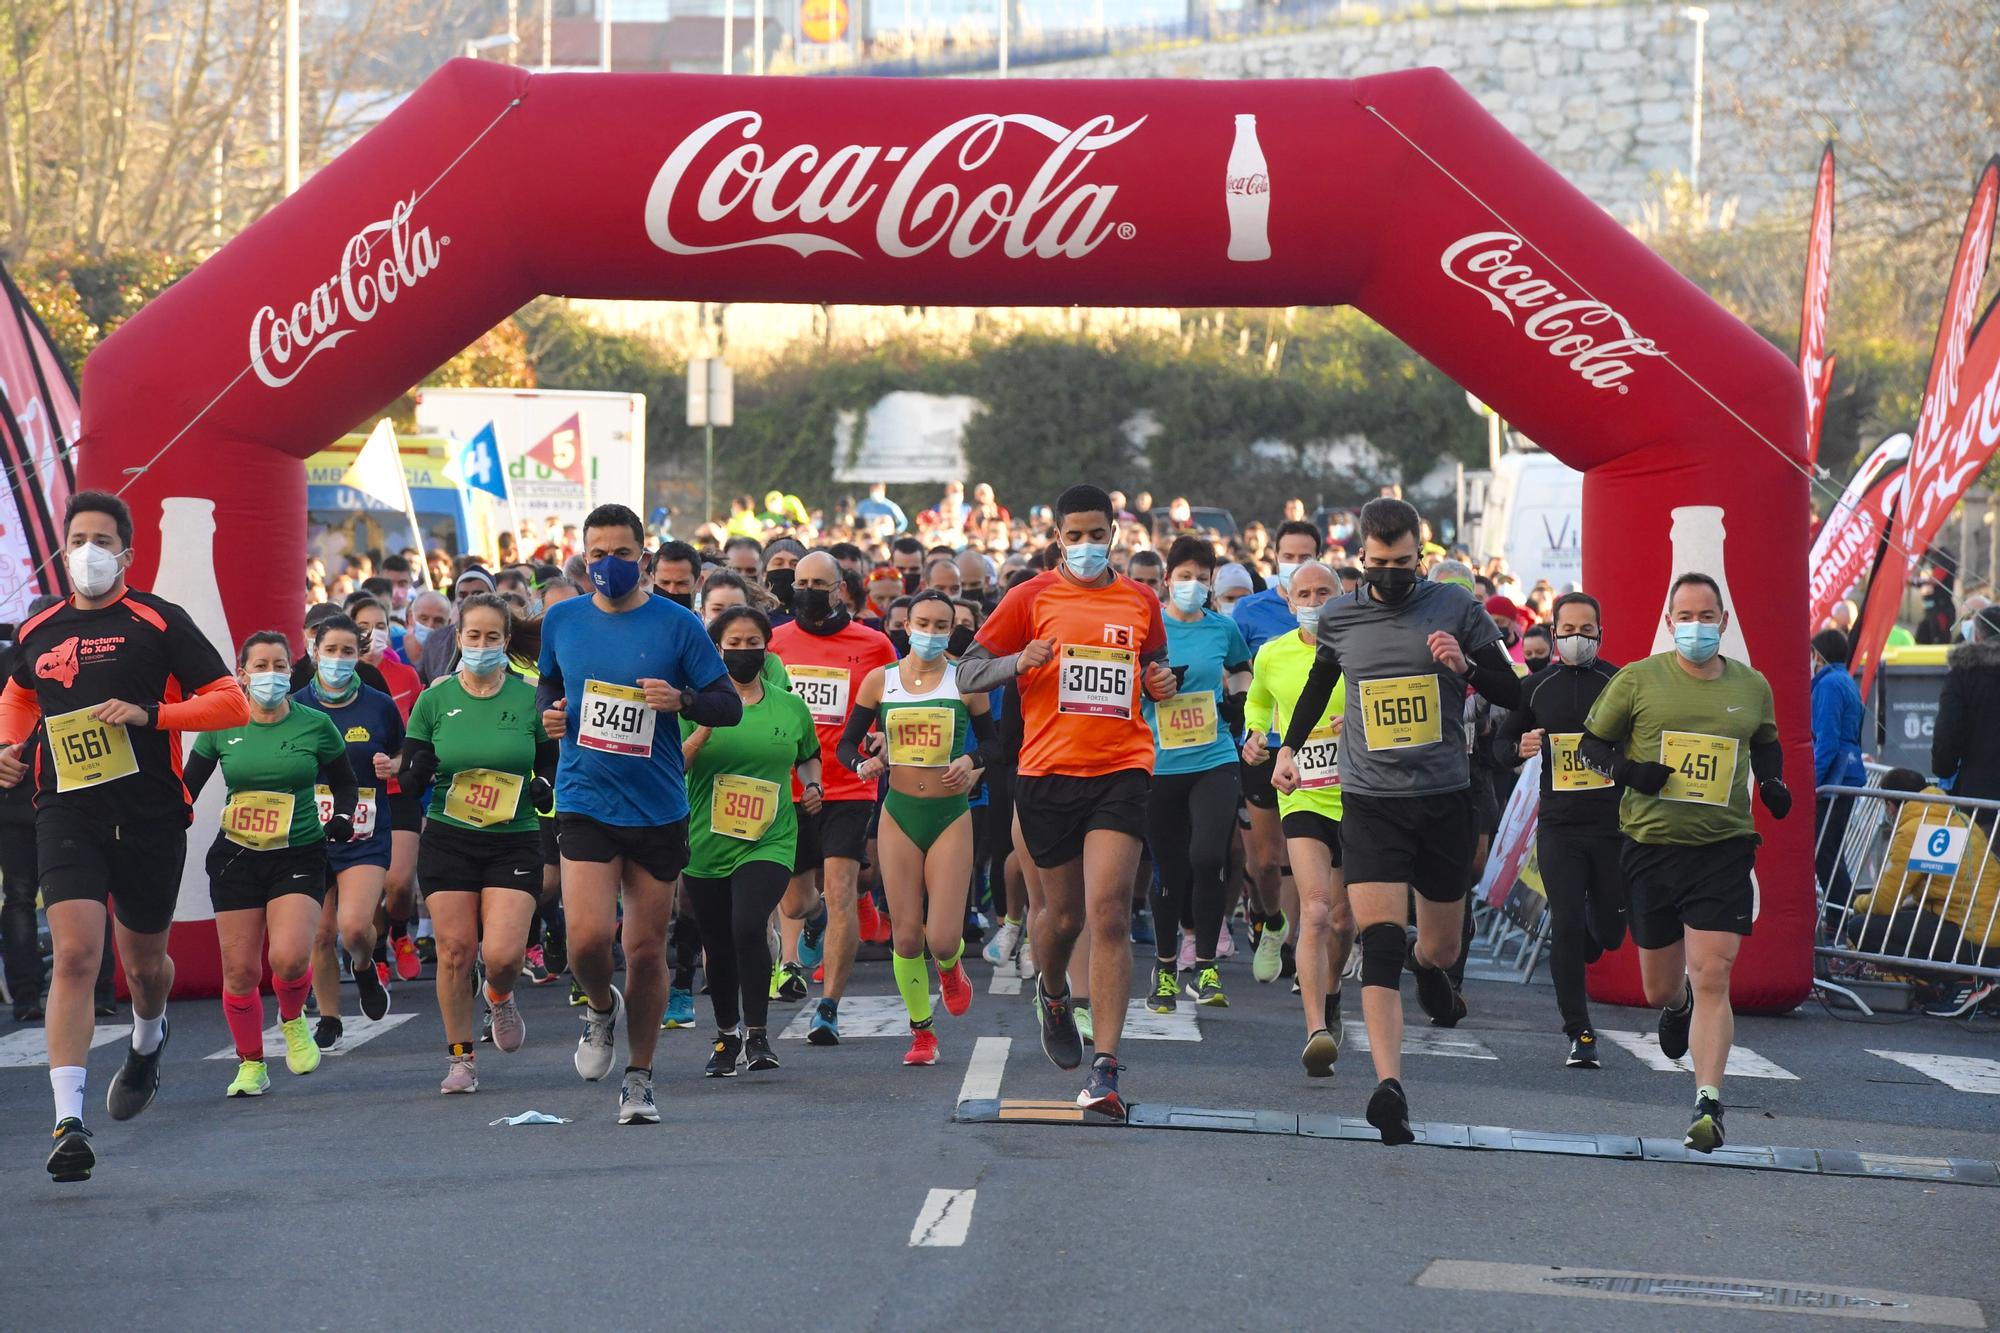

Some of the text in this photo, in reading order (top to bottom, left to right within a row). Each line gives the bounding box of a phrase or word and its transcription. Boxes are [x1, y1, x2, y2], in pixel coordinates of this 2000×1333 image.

[645, 111, 1149, 260] Coca-Cola
[250, 190, 440, 388] Coca-Cola
[1441, 231, 1668, 389] Coca-Cola
[465, 442, 492, 484] 4
[553, 430, 576, 470] 5
[80, 644, 116, 654] do Xalo
[81, 636, 126, 647] Nocturna
[795, 681, 838, 706] 3351
[1069, 664, 1127, 696] 3056
[592, 701, 645, 734] 3491
[1170, 707, 1205, 730] 496
[1374, 695, 1428, 727] 1560
[61, 726, 112, 765] 1561
[897, 724, 941, 748] 1555
[1680, 752, 1718, 781] 451
[465, 783, 500, 811] 391
[724, 792, 765, 821] 390
[231, 806, 280, 834] 1556
